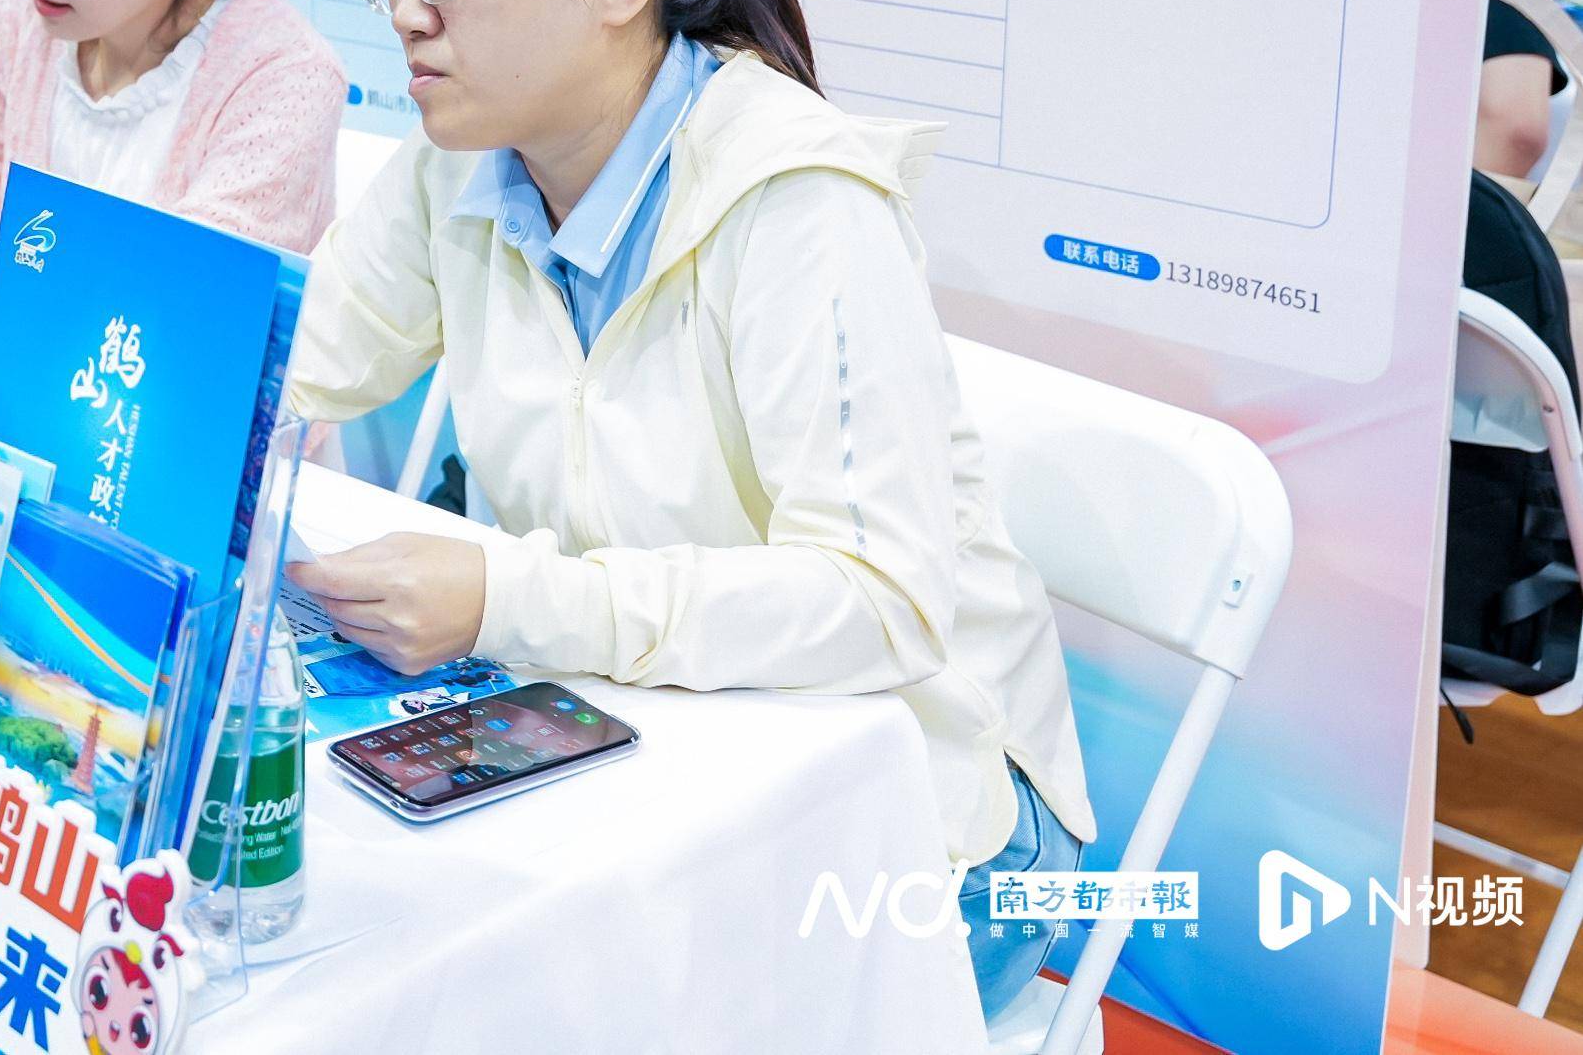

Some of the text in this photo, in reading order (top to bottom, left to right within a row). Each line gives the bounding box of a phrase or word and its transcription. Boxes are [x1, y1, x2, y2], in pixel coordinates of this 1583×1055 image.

[1063, 239, 1321, 314] 联系电话 13189874651
